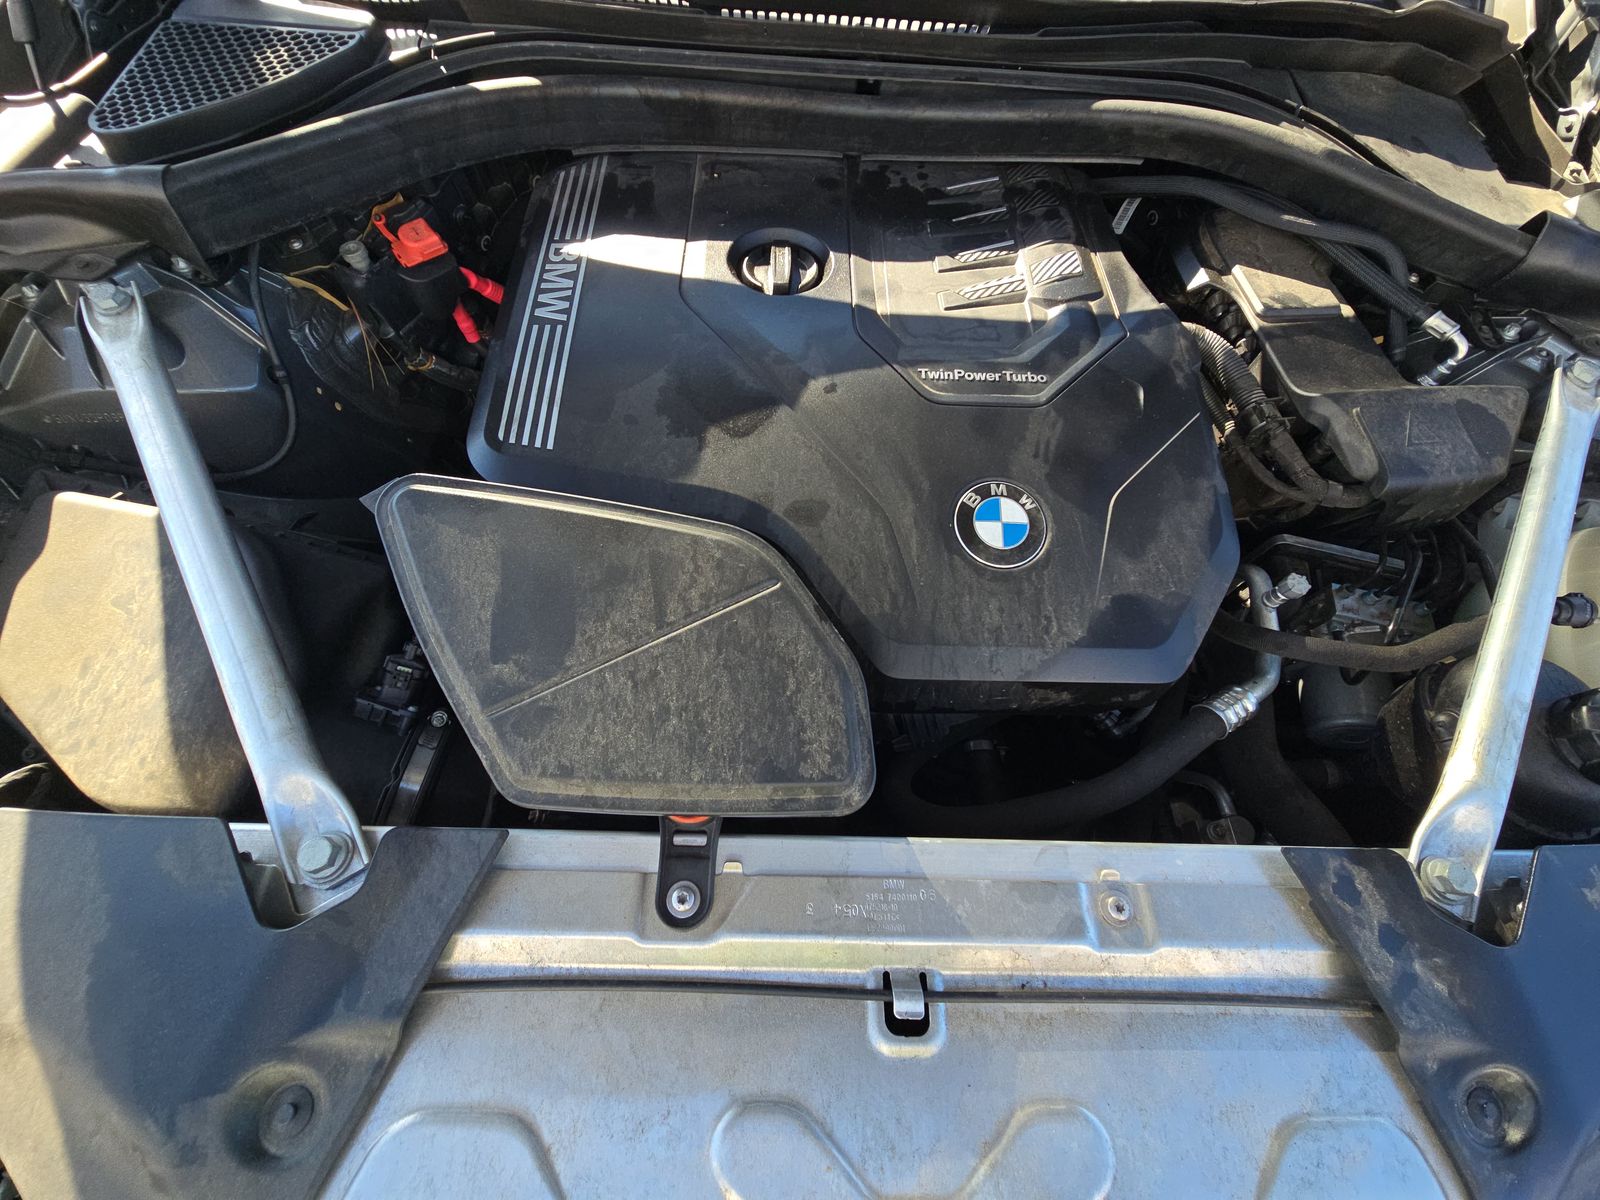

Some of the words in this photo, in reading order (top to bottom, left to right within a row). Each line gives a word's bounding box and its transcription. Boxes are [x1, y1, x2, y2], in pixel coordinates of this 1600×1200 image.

[534, 242, 579, 321] BMW
[918, 368, 1001, 381] TwinPower
[1002, 370, 1047, 383] Turbo
[963, 483, 1036, 511] BMW
[883, 879, 905, 889] BMW
